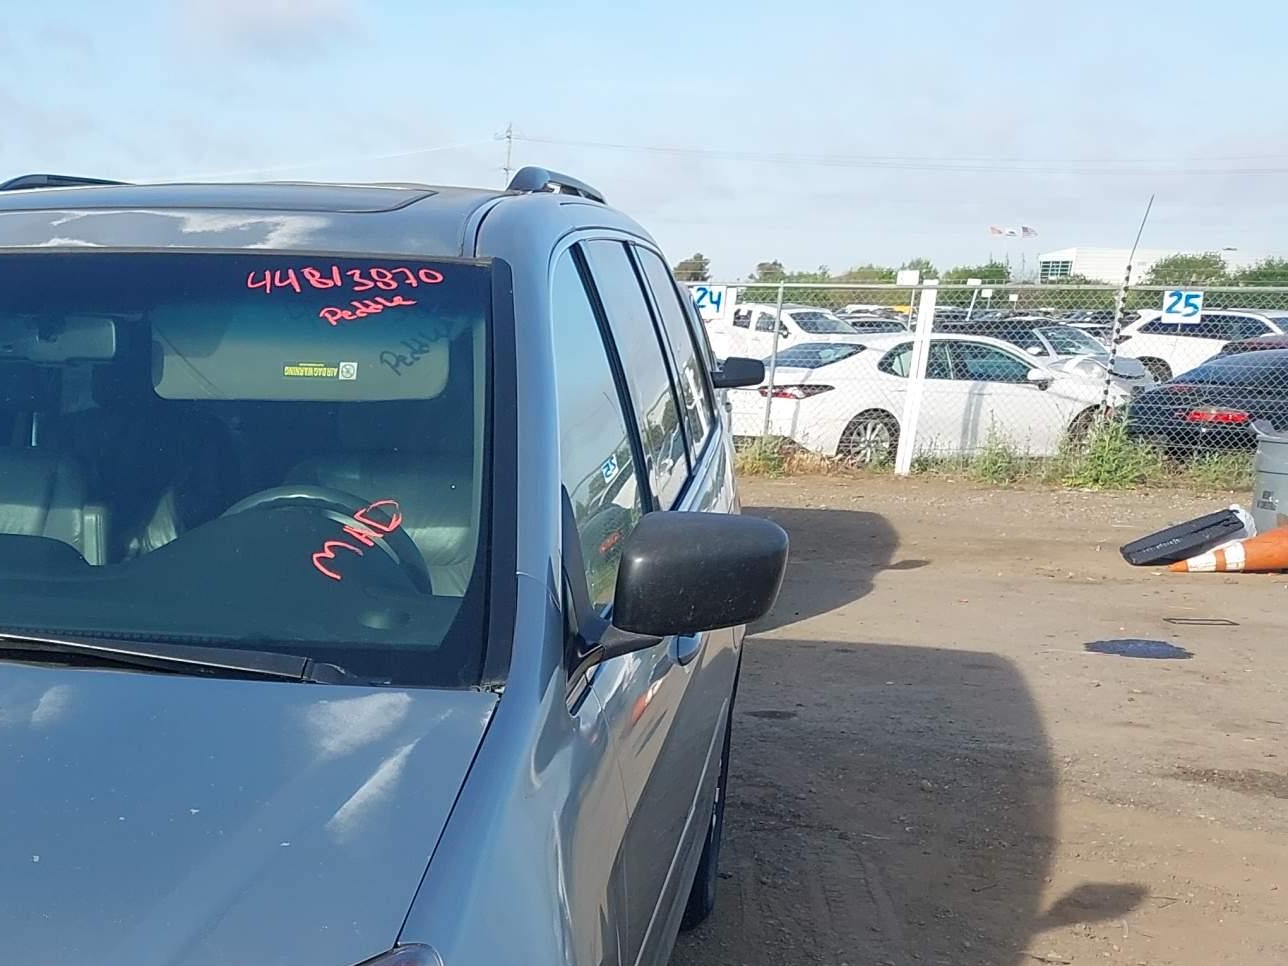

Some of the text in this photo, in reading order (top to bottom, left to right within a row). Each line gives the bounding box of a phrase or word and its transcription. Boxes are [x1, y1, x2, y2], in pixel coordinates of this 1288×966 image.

[246, 265, 444, 294] 44813870
[696, 286, 722, 313] 24
[1165, 289, 1202, 317] 25
